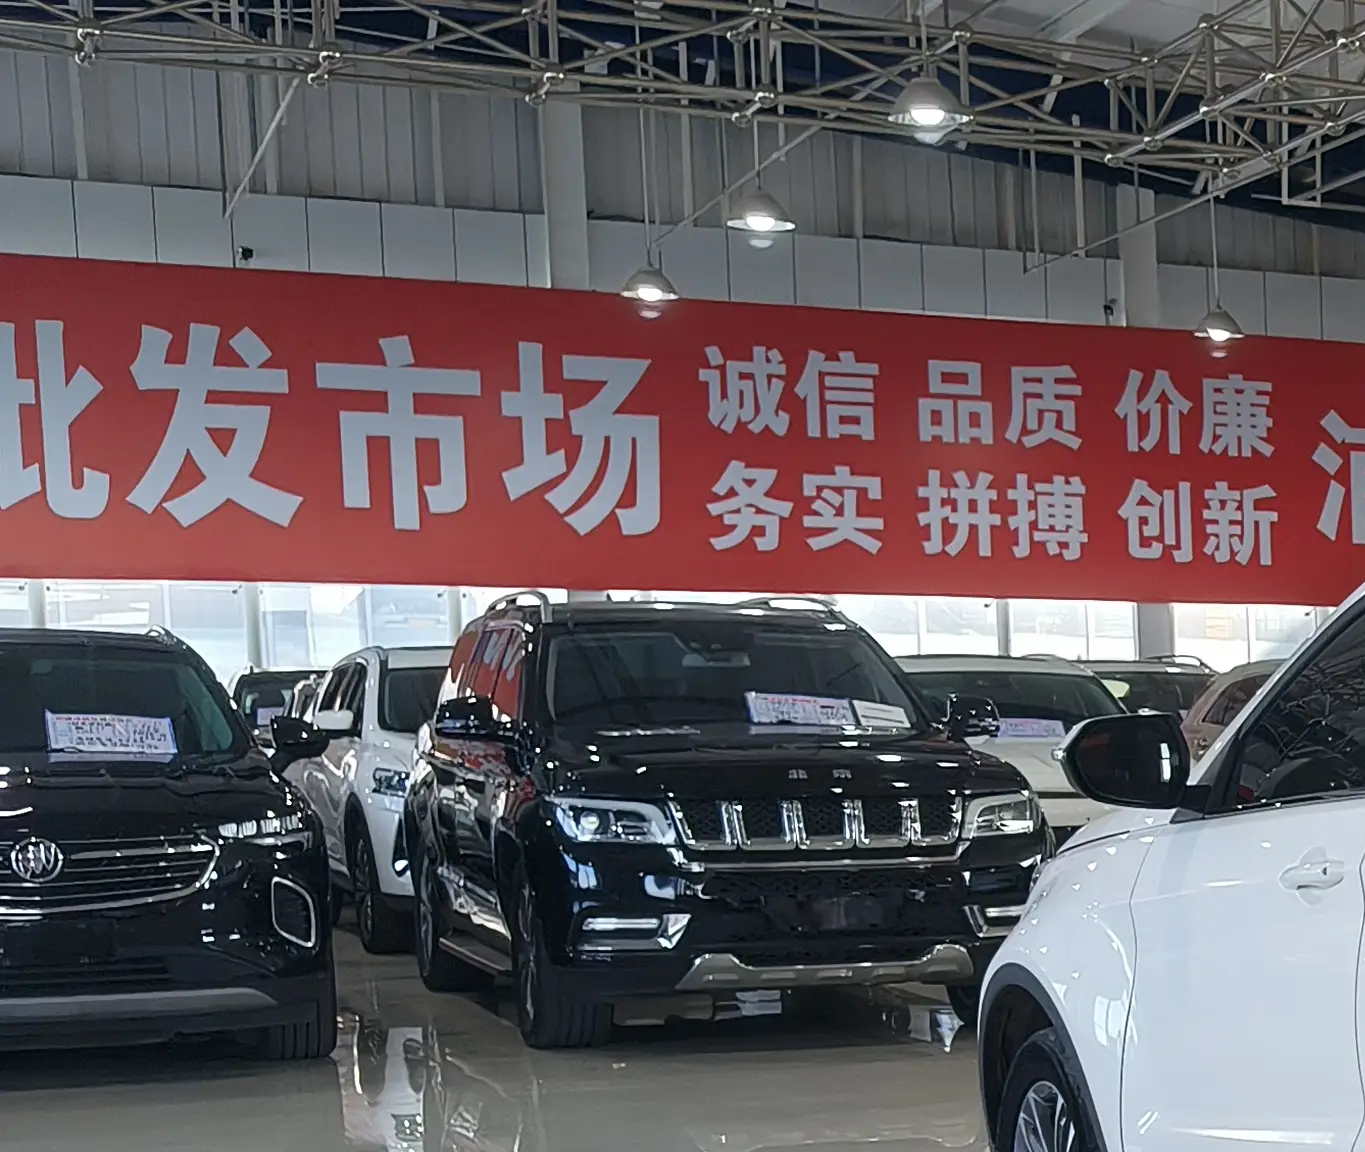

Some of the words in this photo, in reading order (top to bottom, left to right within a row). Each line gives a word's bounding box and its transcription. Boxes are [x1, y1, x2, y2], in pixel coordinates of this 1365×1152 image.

[0, 320, 662, 536] 批发市场
[699, 345, 880, 441] 诚信
[918, 359, 1082, 450] 品质
[1115, 369, 1274, 457] 价廉
[706, 460, 884, 554] 务实
[917, 469, 1089, 561] 拼搏
[1118, 479, 1278, 566] 创新
